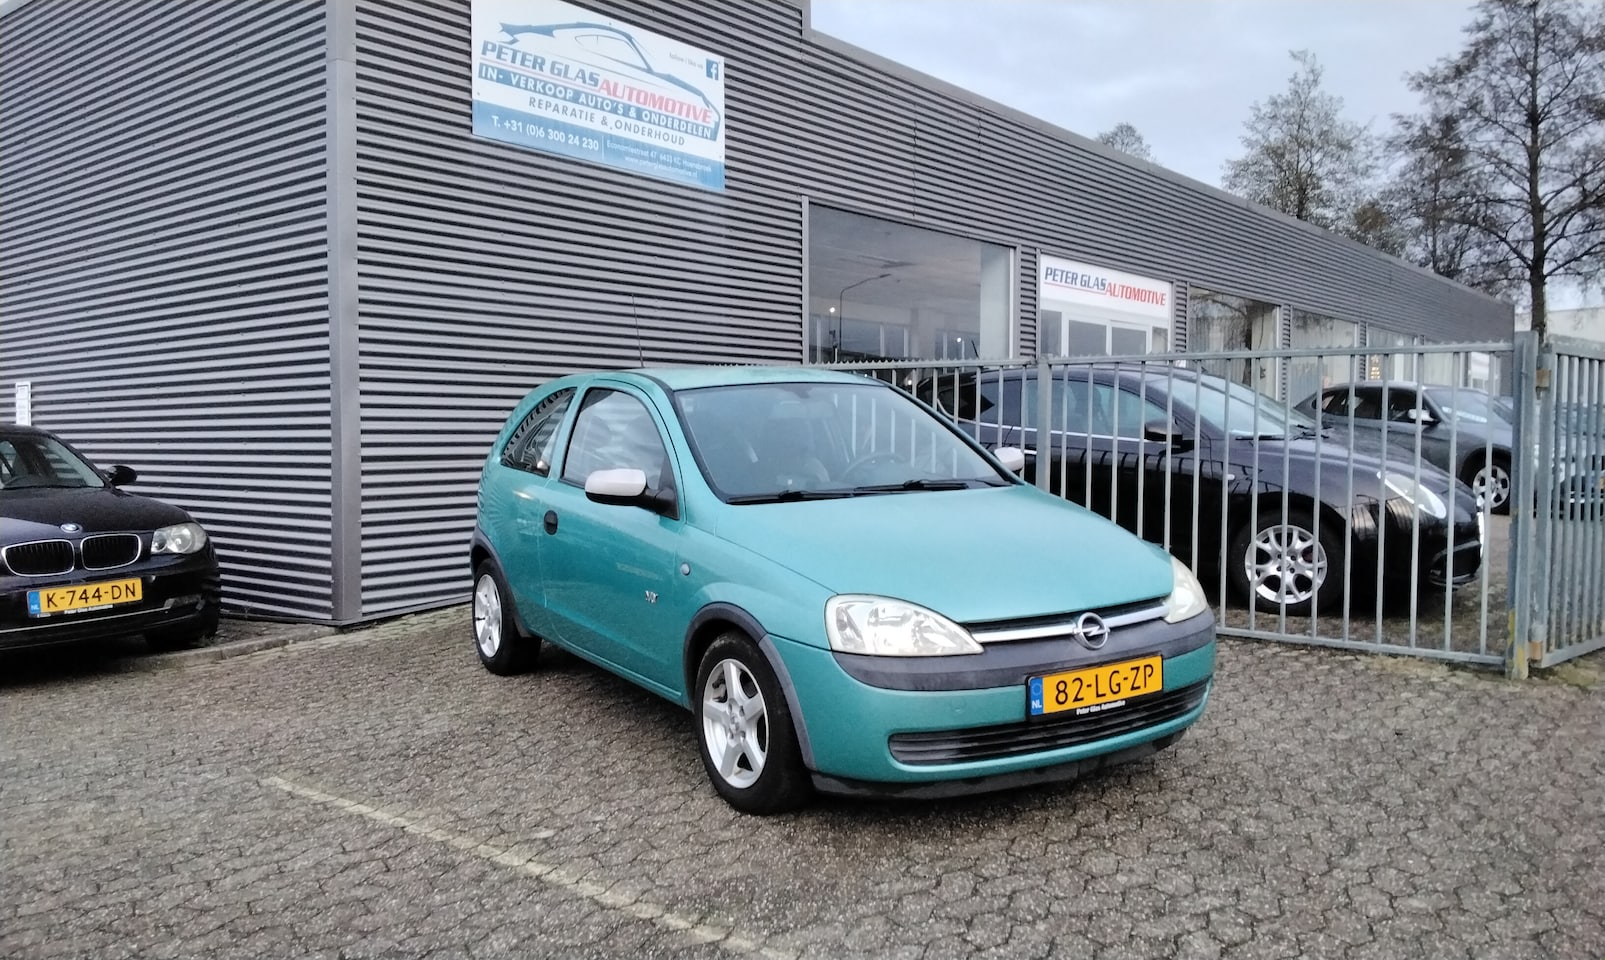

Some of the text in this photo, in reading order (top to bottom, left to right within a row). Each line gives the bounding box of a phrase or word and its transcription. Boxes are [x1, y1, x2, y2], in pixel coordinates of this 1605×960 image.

[481, 40, 712, 124] PETER GLAS AUTOMOTIVE
[481, 65, 711, 139] IN- VERKOOP AUTO'S & ONDERDELEN
[492, 115, 599, 151] T. +31 (0)6 300 24 230
[529, 97, 685, 146] REPARATIE & ONDERHOUD
[1045, 266, 1167, 306] PETER GLAS AUTOMOTIVE
[46, 583, 136, 608] K-744-DN
[1031, 699, 1042, 709] NL
[1055, 664, 1154, 705] 82-LG-ZP
